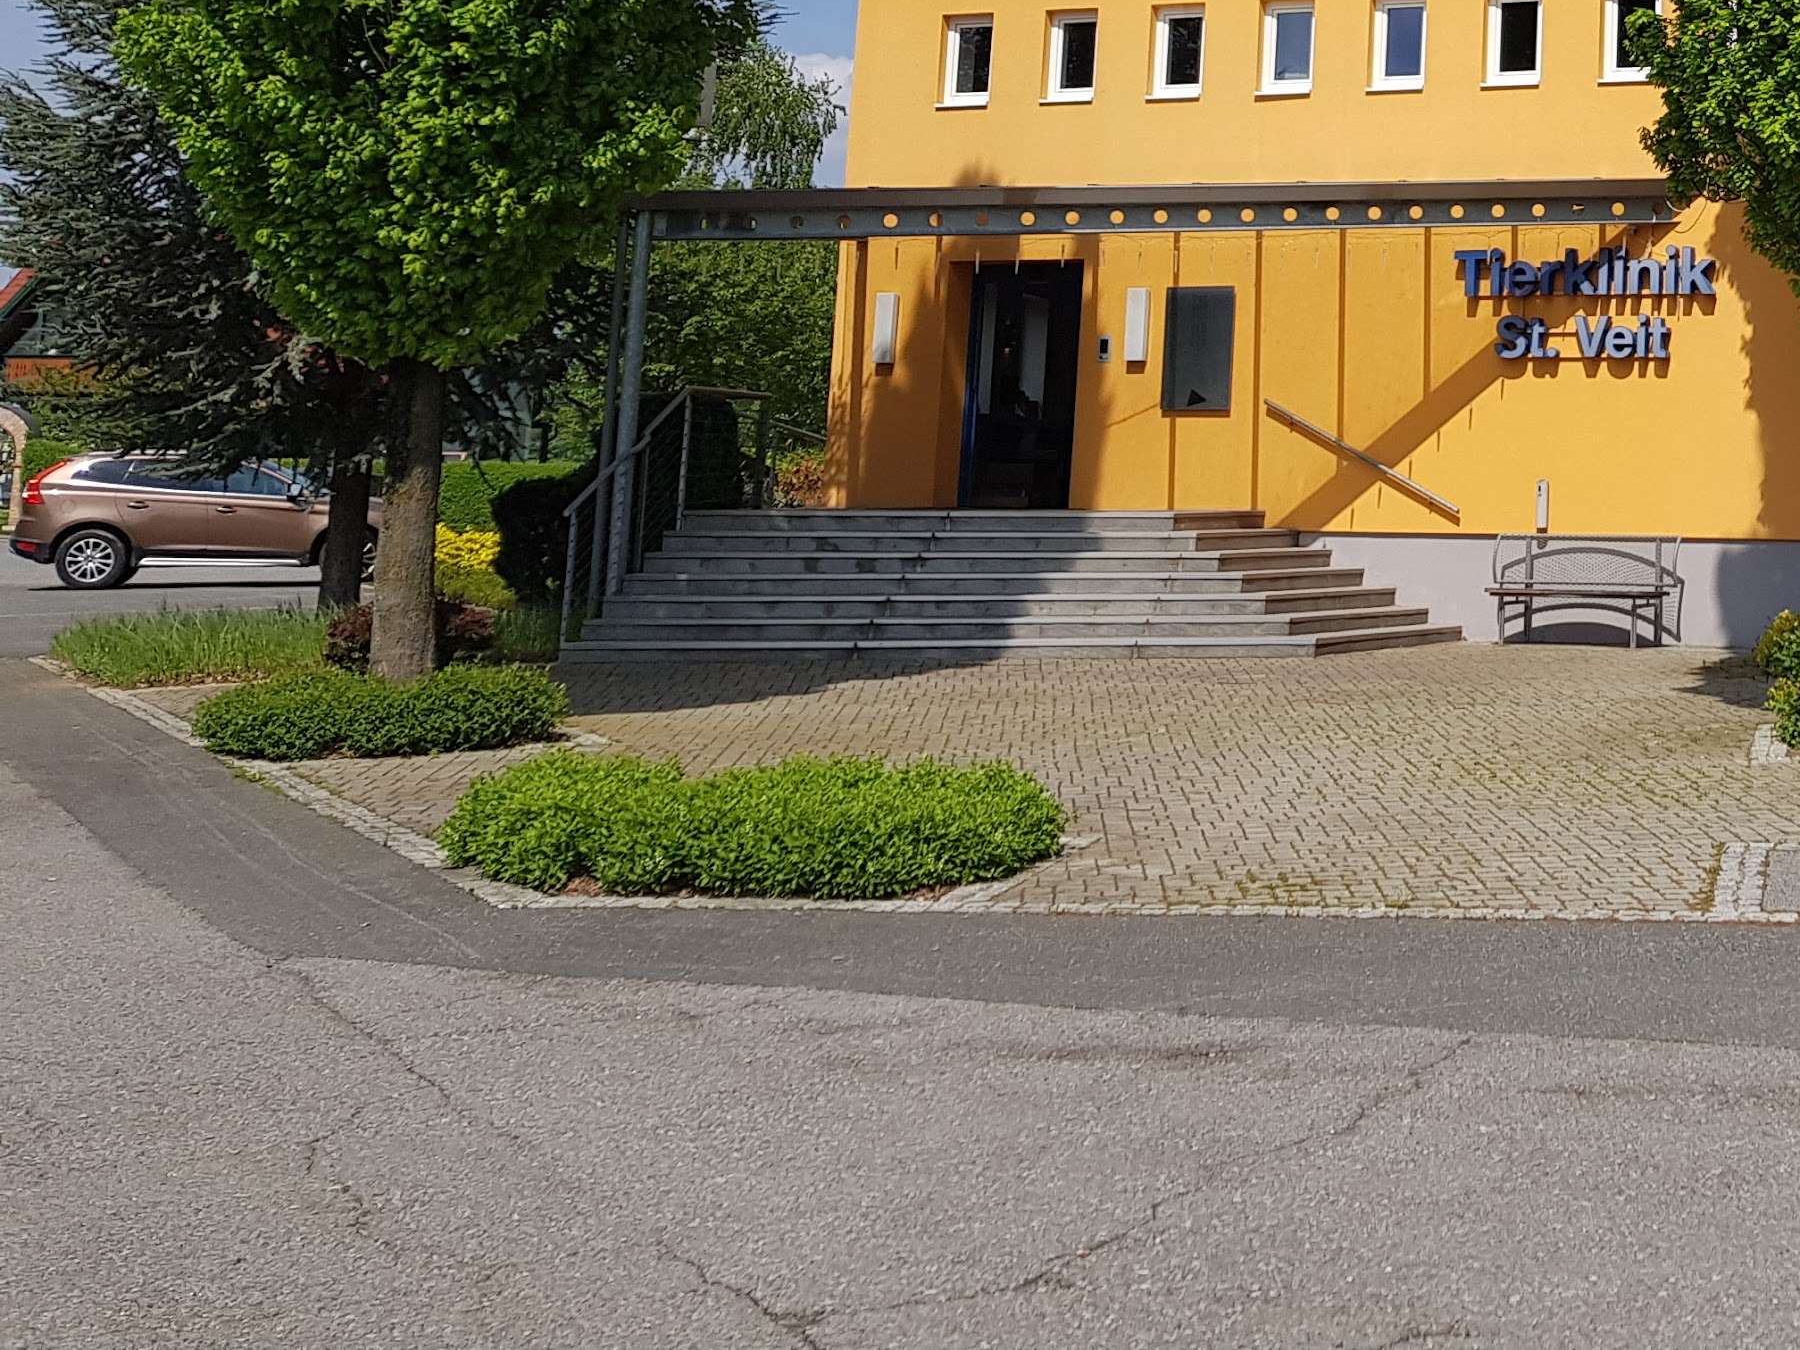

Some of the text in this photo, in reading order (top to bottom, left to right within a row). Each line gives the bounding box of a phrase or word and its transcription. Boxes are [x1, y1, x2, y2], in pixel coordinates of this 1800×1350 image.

[1454, 245, 1715, 297] Tierklinik
[1495, 313, 1671, 359] St. Veit
